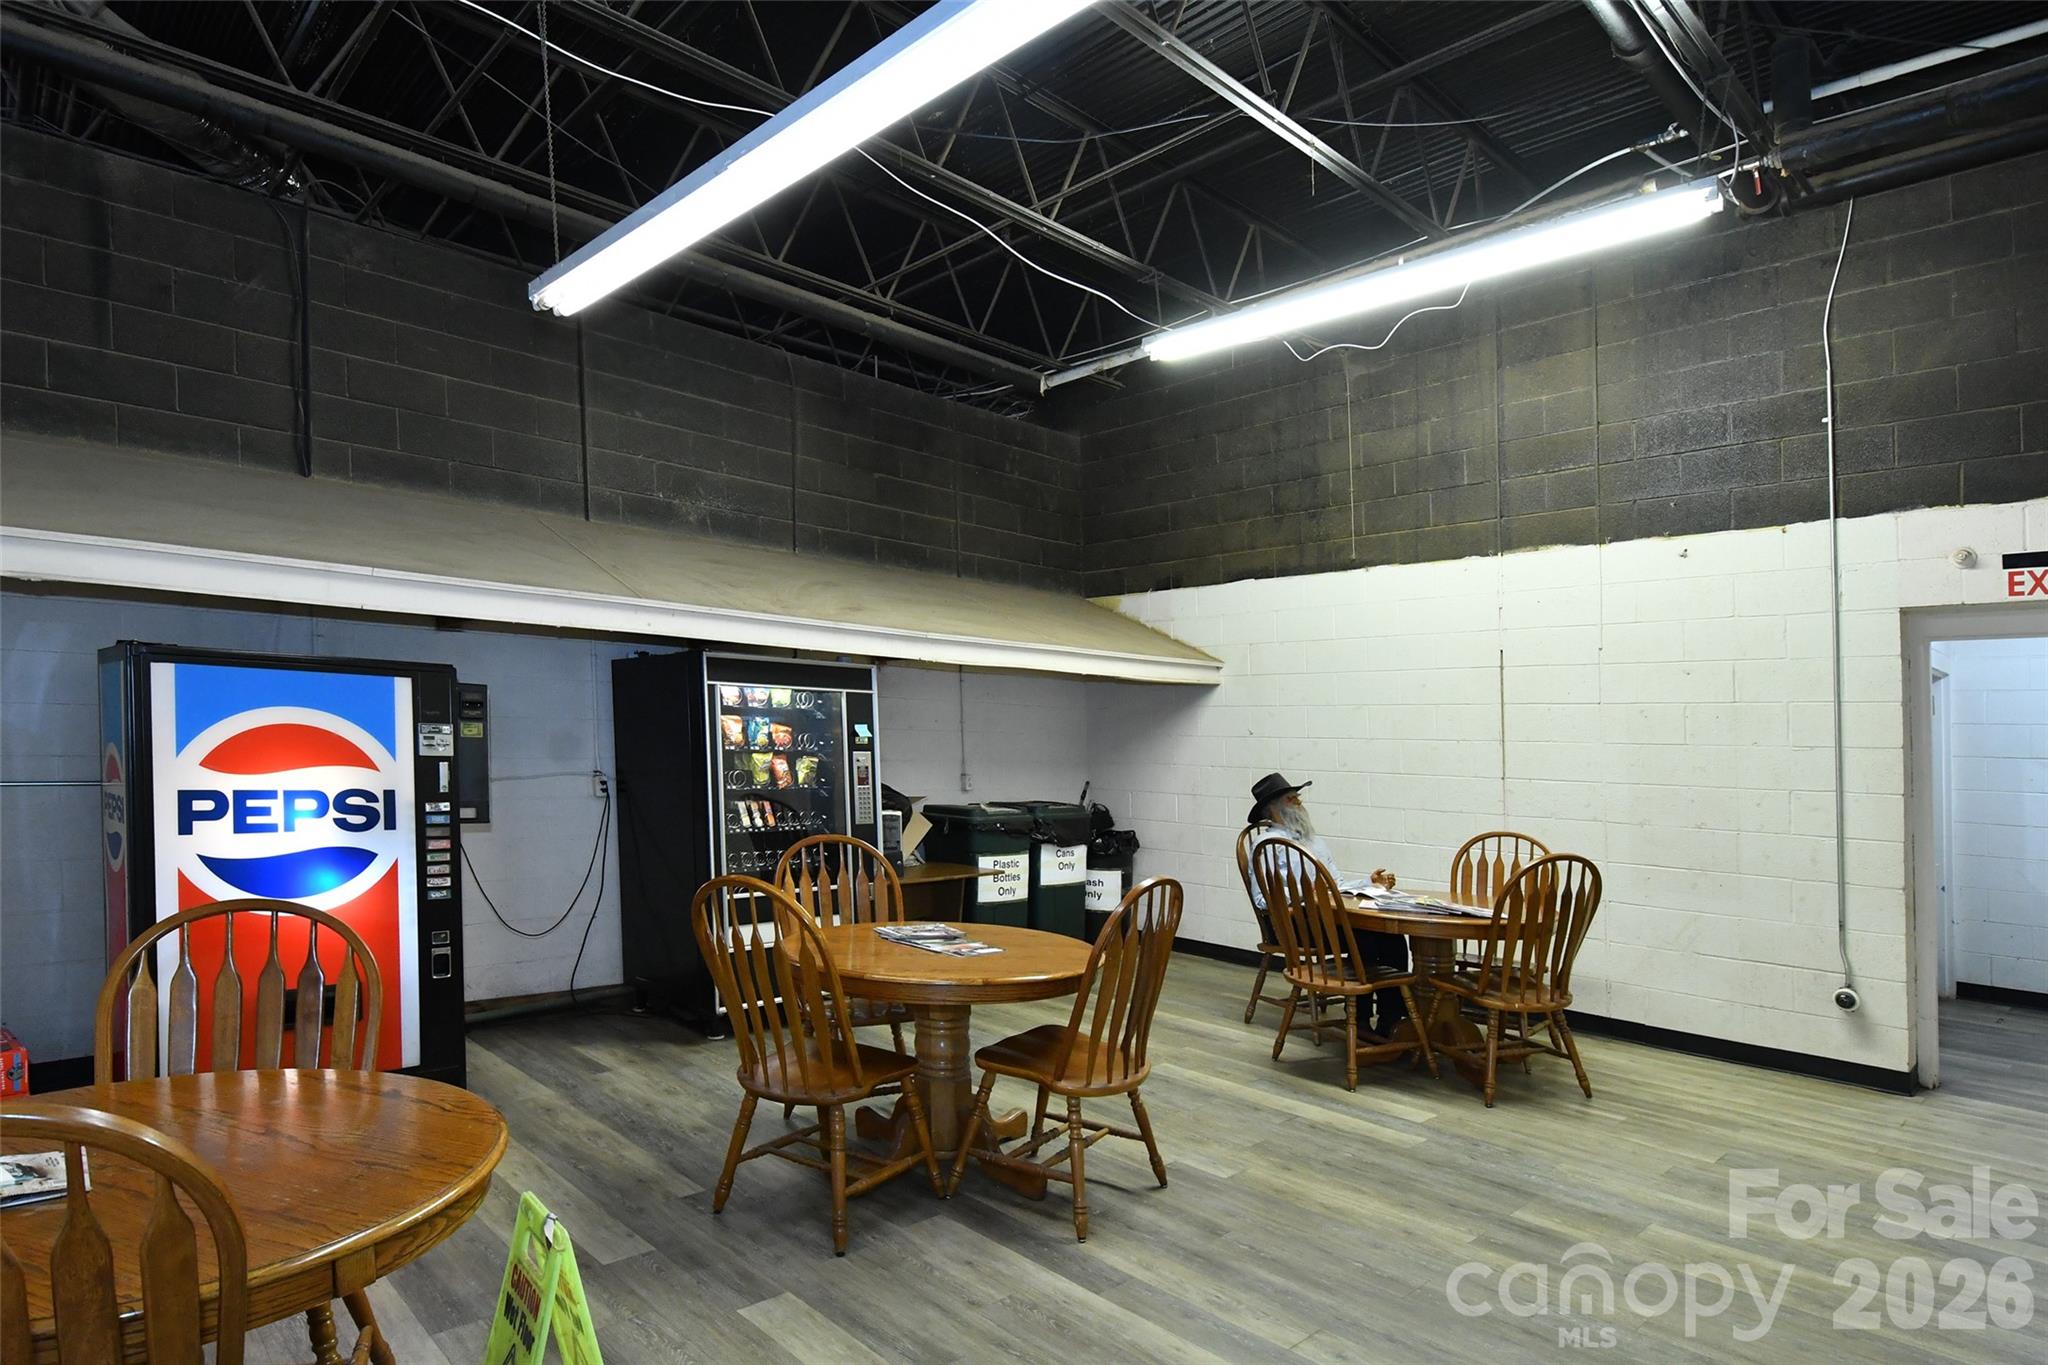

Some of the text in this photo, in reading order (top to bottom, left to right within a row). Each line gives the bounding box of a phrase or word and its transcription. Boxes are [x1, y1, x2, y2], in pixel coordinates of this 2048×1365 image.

[2008, 568, 2048, 597] EX
[177, 788, 396, 835] PEPSI
[1056, 849, 1075, 858] Cans
[993, 859, 1020, 869] Plastic
[1058, 861, 1076, 872] Only
[993, 872, 1021, 883] Bottles
[1086, 879, 1104, 887] ash
[998, 886, 1017, 897] Only
